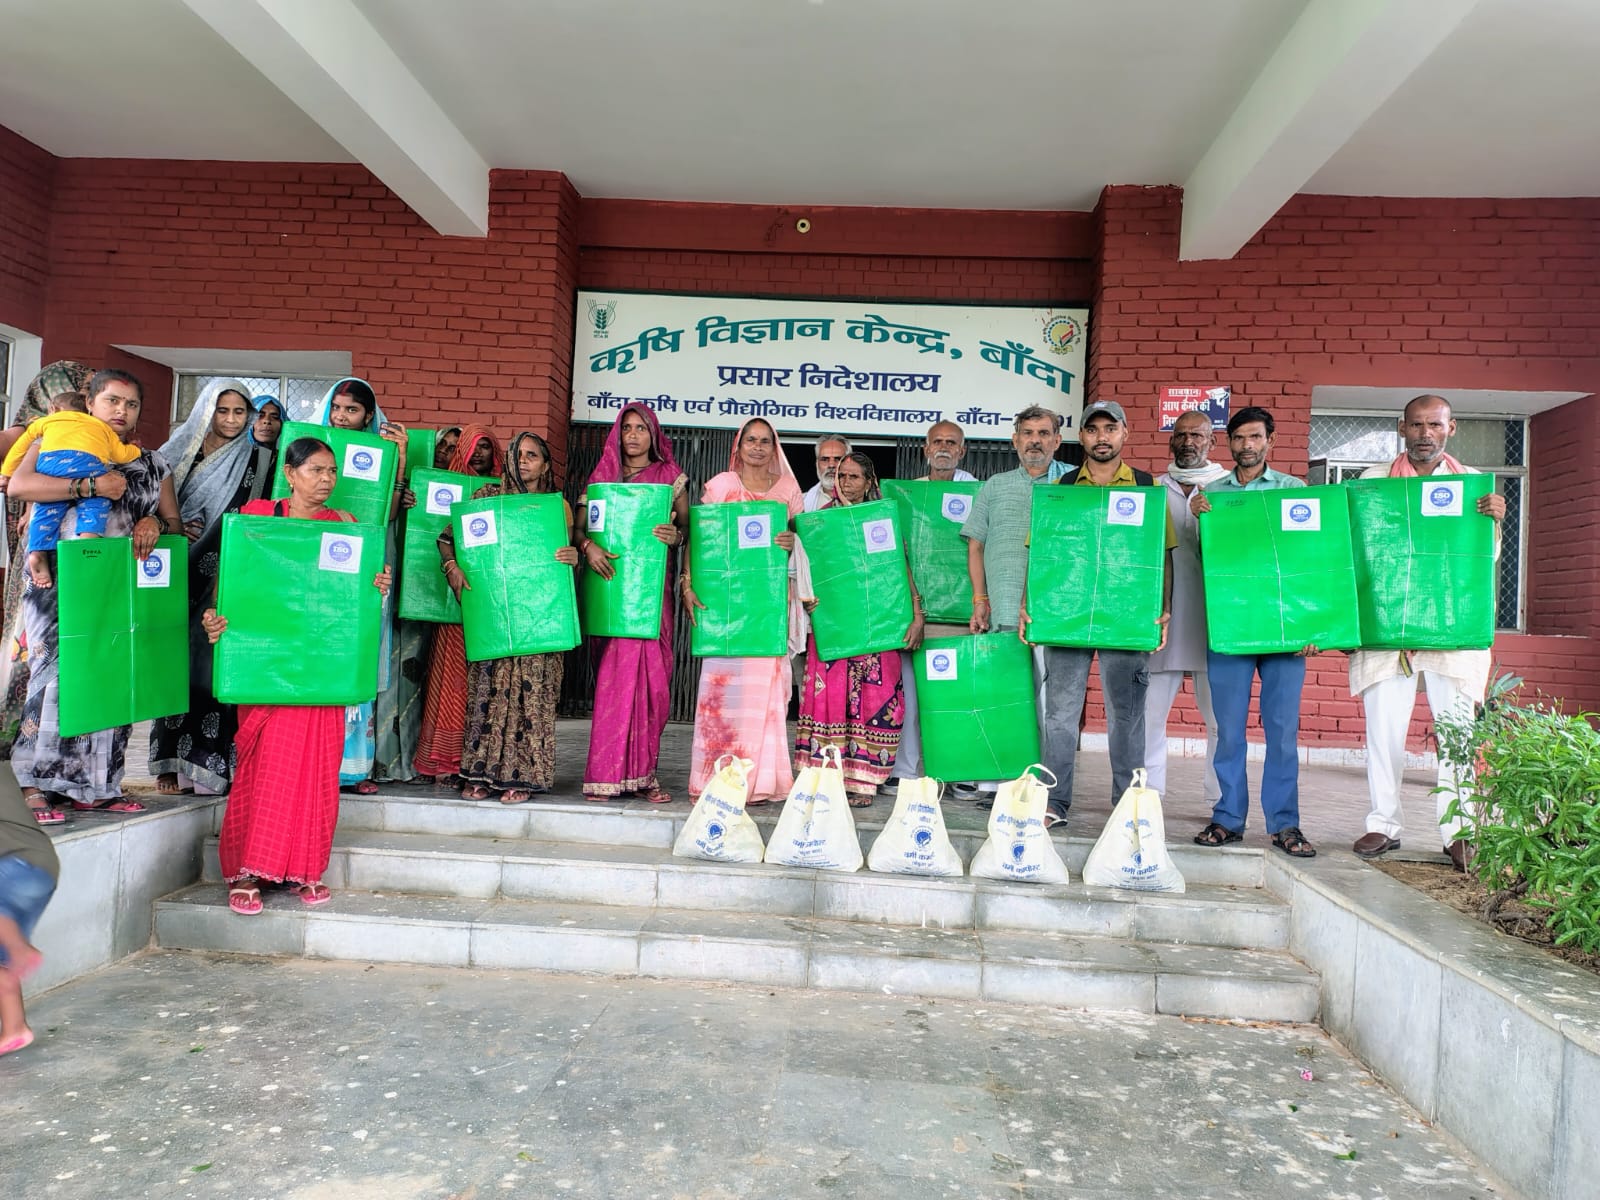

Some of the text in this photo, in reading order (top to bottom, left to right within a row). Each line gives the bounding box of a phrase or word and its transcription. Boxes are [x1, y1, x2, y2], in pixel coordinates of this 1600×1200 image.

[590, 314, 1076, 395] कृषि विज्ञान केन्द्र, बाँदा
[717, 363, 942, 393] प्रसार निदेशालय
[587, 391, 630, 410] बाँदा
[683, 396, 715, 414] एवं
[718, 397, 809, 418] प्रौद्योगिक
[815, 401, 943, 423] विश्वविद्यालय
[1163, 401, 1179, 411] आप
[1199, 399, 1210, 411] की
[472, 522, 486, 530] ISO
[333, 545, 349, 553] ISO
